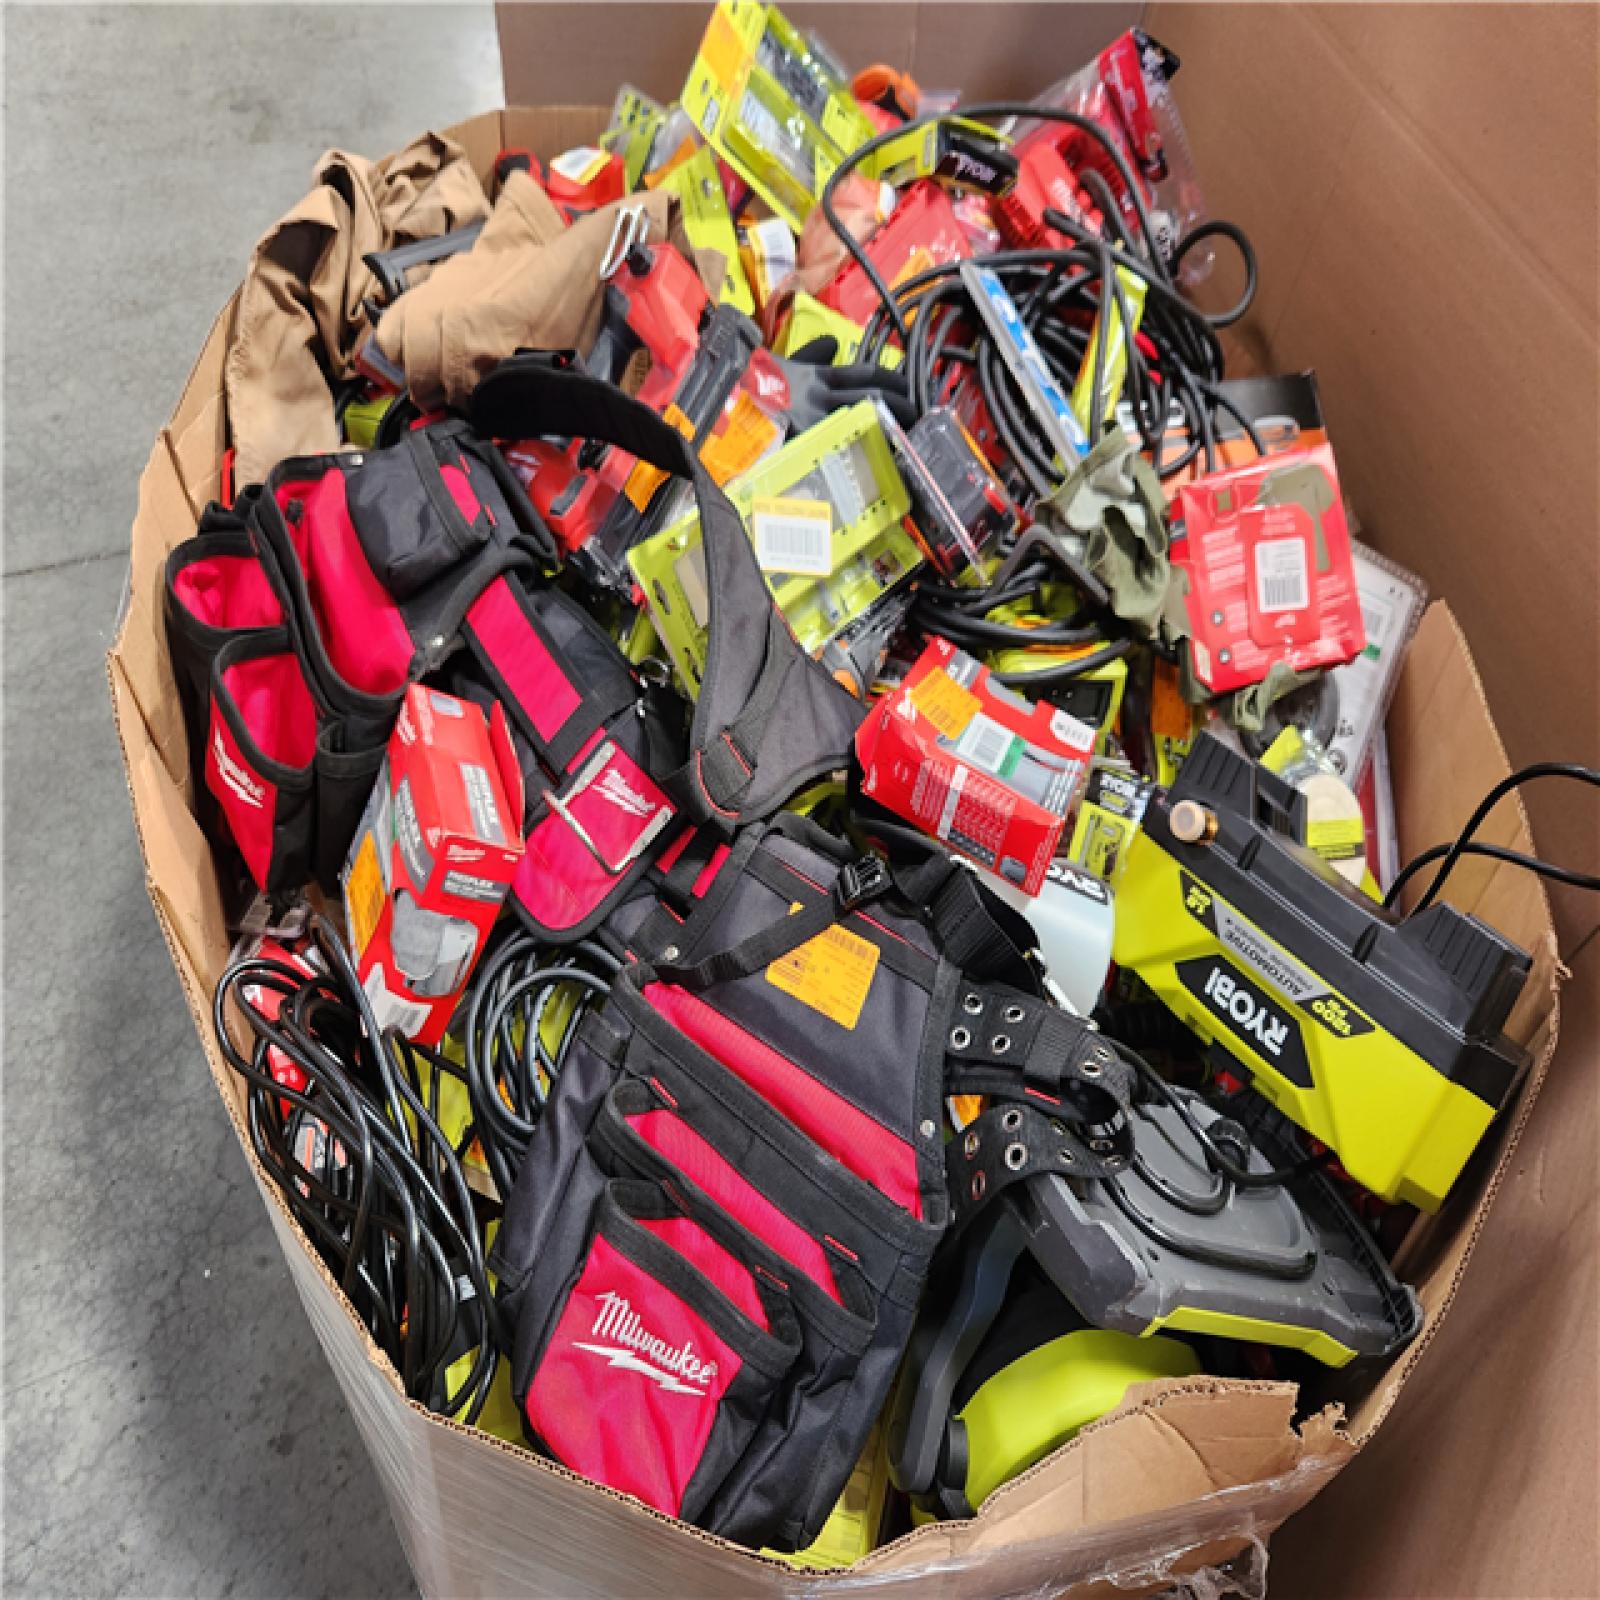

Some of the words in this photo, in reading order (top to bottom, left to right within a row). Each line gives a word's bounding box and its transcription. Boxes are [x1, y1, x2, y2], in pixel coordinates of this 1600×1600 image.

[1225, 929, 1303, 997] AUTOMOTIVE
[1204, 967, 1289, 1056] RYOBI
[591, 1291, 711, 1384] Milwaukee
